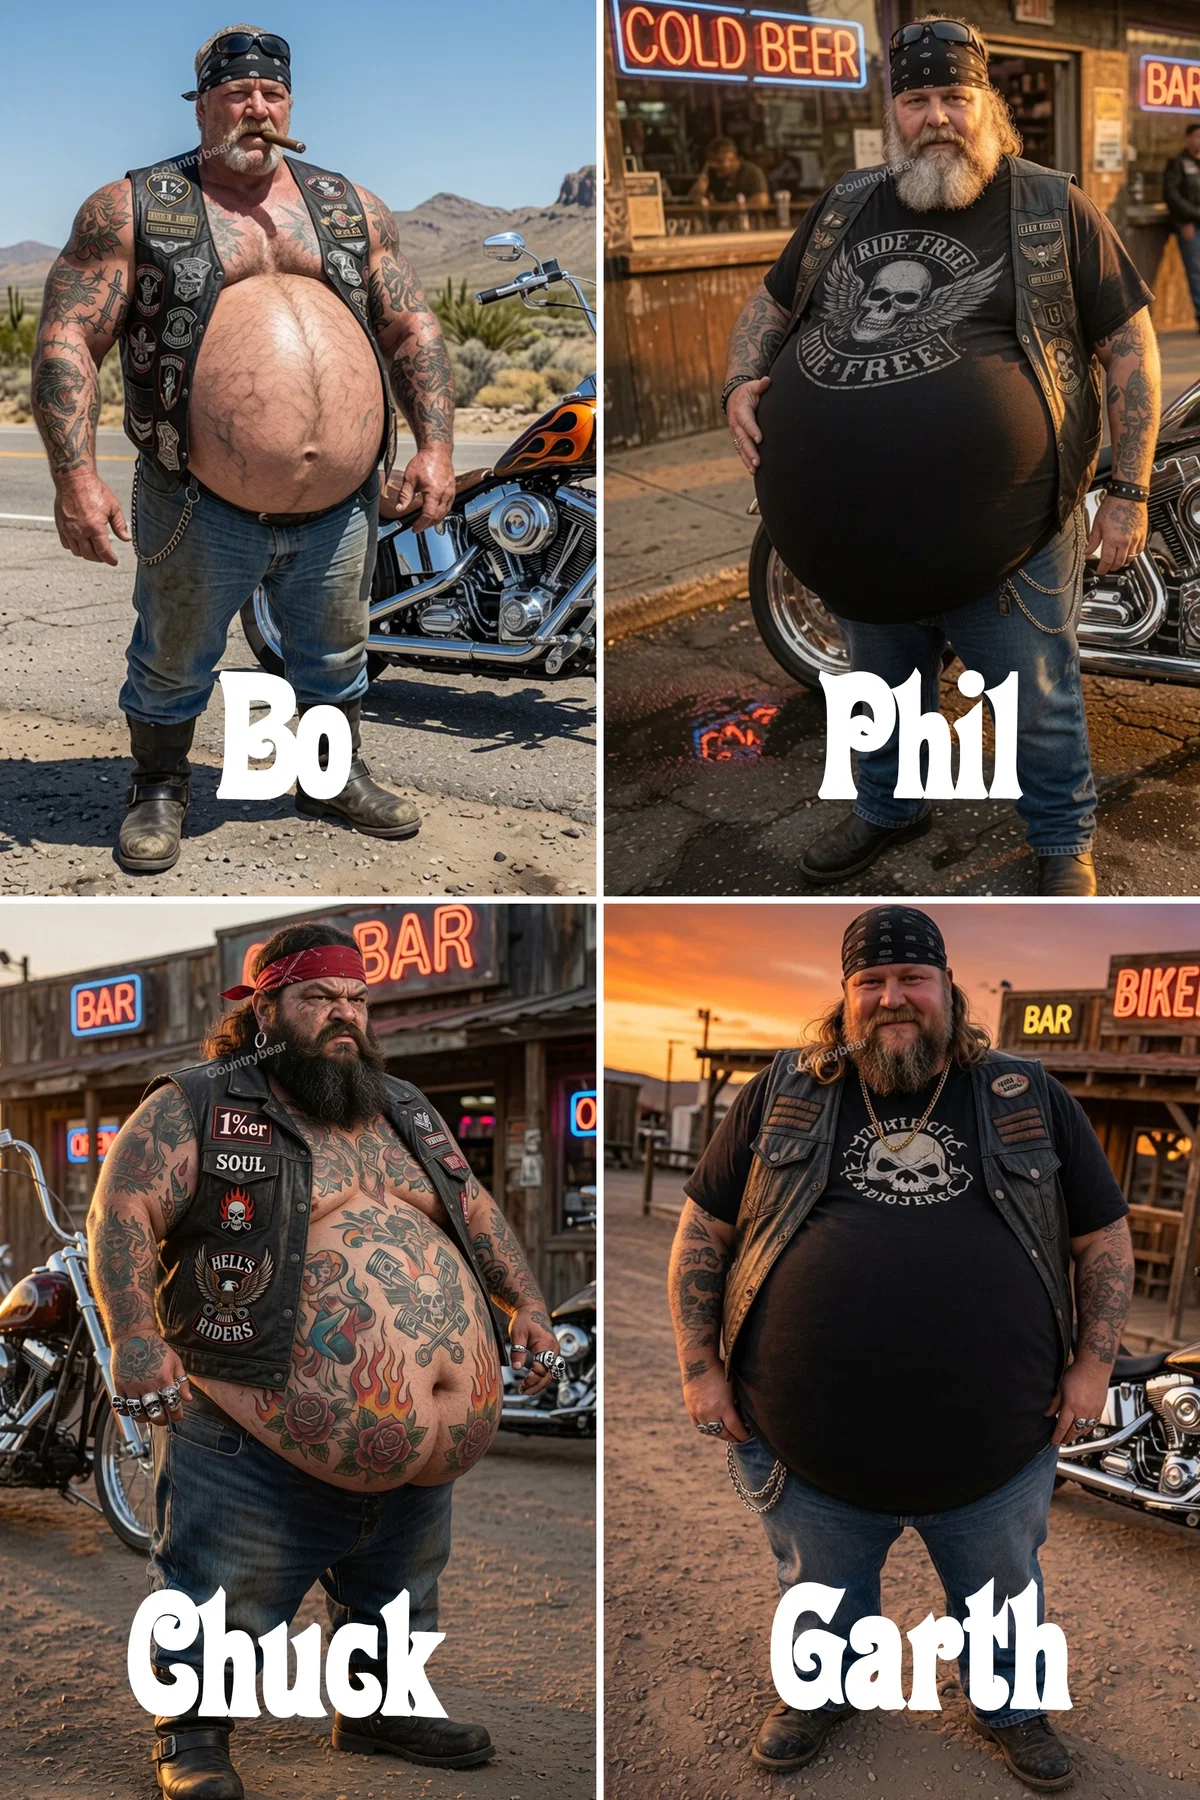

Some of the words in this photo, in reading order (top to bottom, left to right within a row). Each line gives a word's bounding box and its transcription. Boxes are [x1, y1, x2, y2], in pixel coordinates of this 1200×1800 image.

[625, 6, 746, 69] COLD
[760, 21, 860, 78] BEER
[1147, 62, 1200, 107] BAR
[857, 234, 909, 261] RIDE
[915, 234, 971, 270] FREE
[837, 344, 944, 383] FREE
[76, 982, 136, 1030] BAR
[1113, 966, 1200, 1018] BIKE
[1023, 1004, 1073, 1035] BAR
[219, 1111, 268, 1138] 1%er
[216, 1153, 266, 1173] SOUL
[211, 1253, 256, 1274] HELL'S
[196, 1316, 255, 1342] RIDERS
